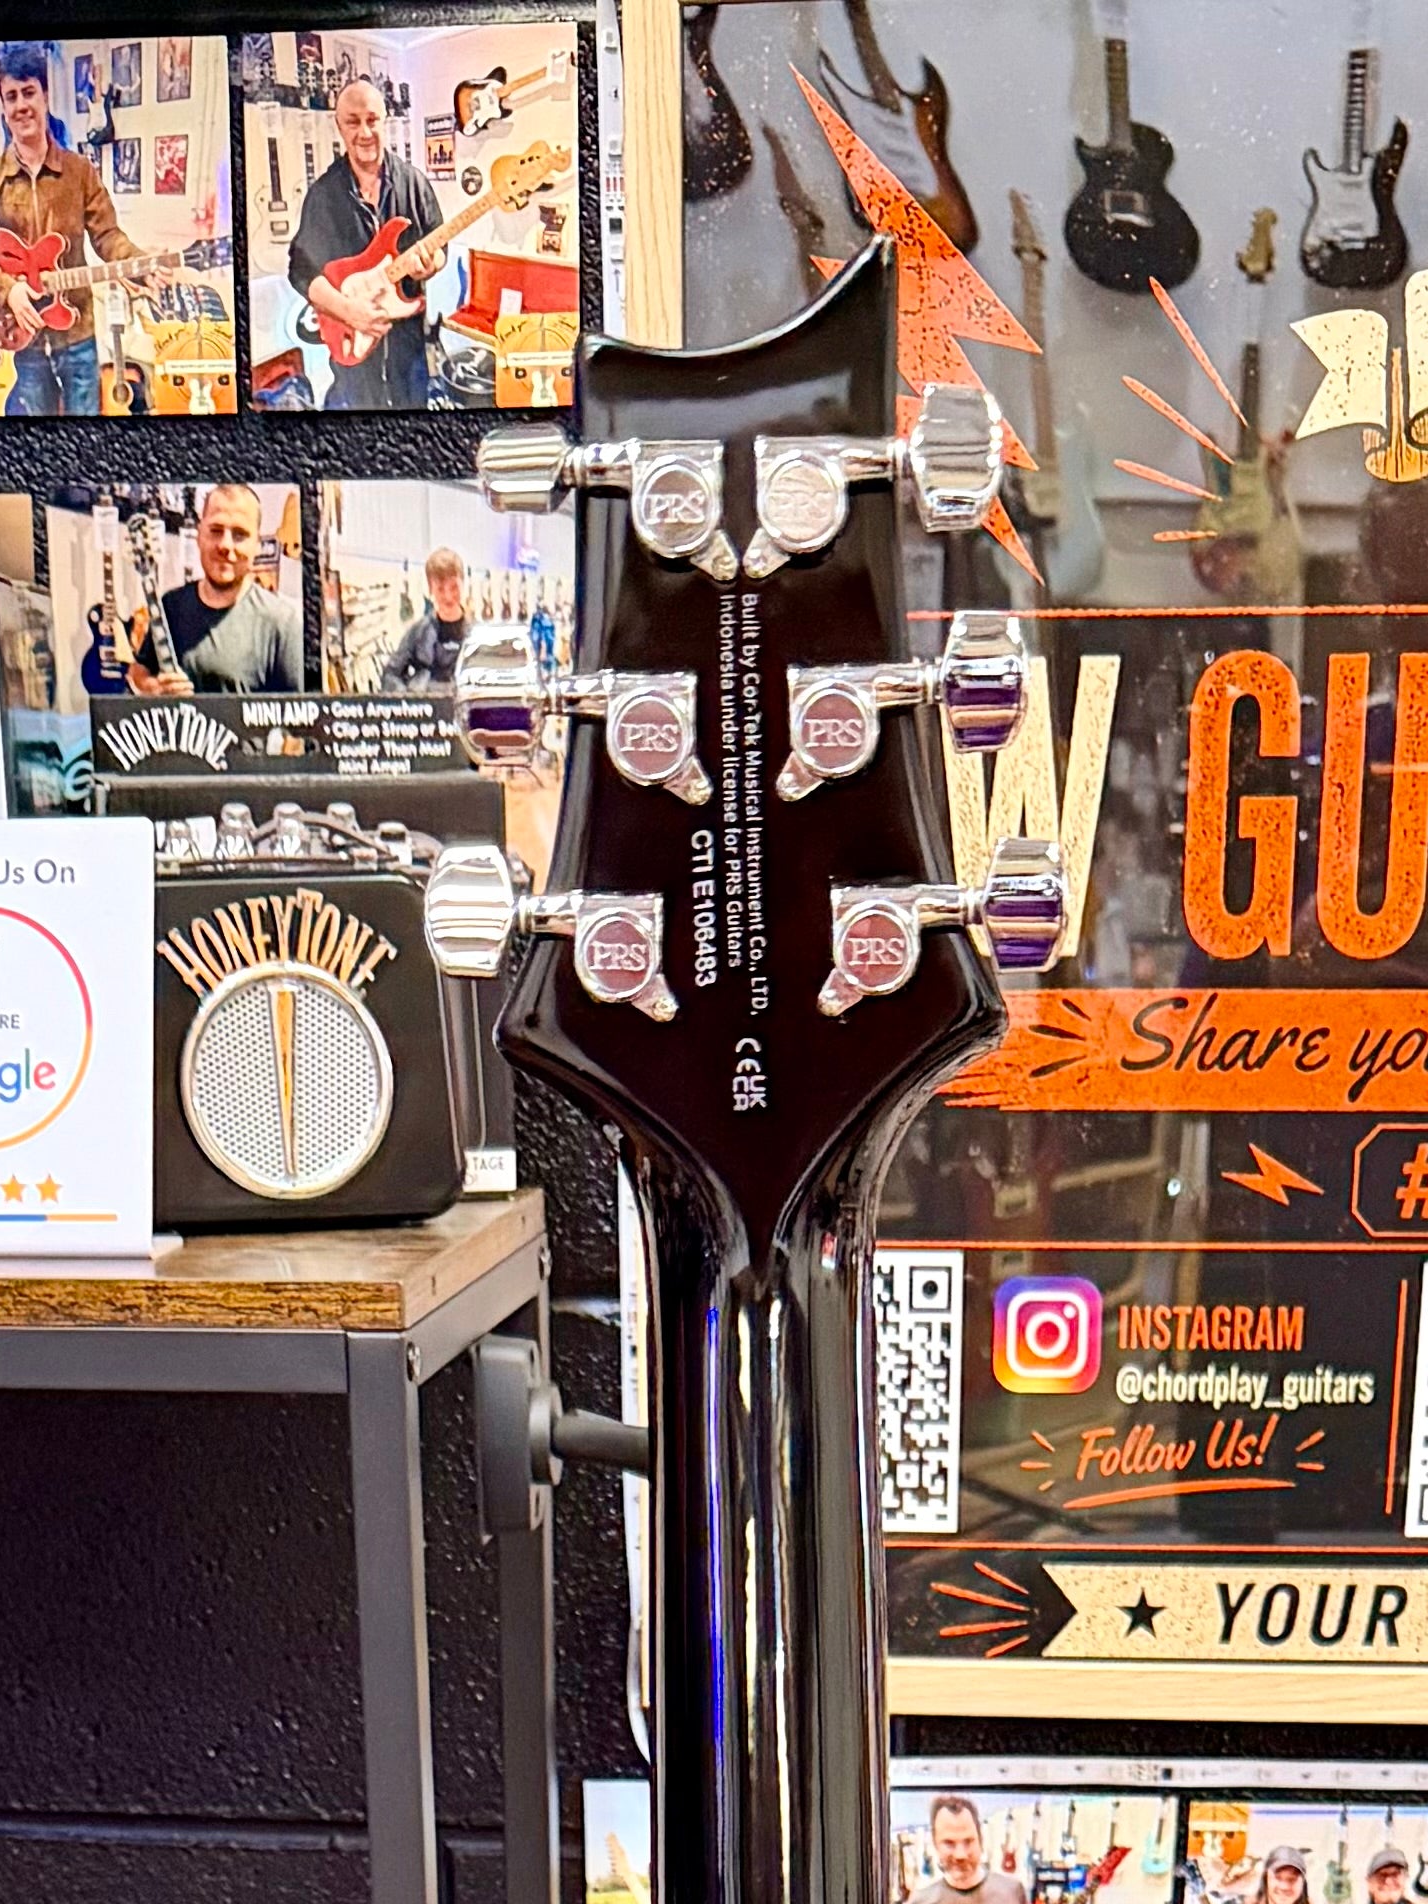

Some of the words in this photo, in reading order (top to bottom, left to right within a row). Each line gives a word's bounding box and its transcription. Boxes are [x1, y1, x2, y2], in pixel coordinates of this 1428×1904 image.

[644, 489, 705, 525] PRS
[719, 594, 737, 684] Indonesia
[741, 594, 760, 641] Built
[738, 645, 761, 668] by
[243, 701, 280, 726] MINI
[283, 701, 320, 727] AMP
[366, 700, 433, 720] Anywhere
[721, 685, 738, 752] under
[804, 718, 863, 748] PRS
[98, 702, 239, 773] HONEYTONE
[621, 722, 679, 754] PRS
[721, 754, 740, 825] license
[745, 749, 764, 819] Musical
[940, 653, 1121, 959] W
[724, 828, 741, 857] for
[33, 859, 76, 886] On
[725, 861, 742, 896] PRS
[746, 824, 766, 928] Instrument
[158, 887, 397, 1000] HONEYTONE
[588, 940, 646, 971] PRS
[692, 879, 718, 987] E106483
[725, 899, 742, 967] Guitars
[848, 937, 905, 967] PRS
[1120, 993, 1332, 1074] Share
[471, 1155, 505, 1171] TAGE
[1118, 1305, 1305, 1353] INSTAGRAM
[1115, 1362, 1374, 1410] @chordplay_guitars
[1076, 1424, 1196, 1481] Follow
[1206, 1413, 1280, 1471] Us!
[1214, 1581, 1409, 1648] YOUR
